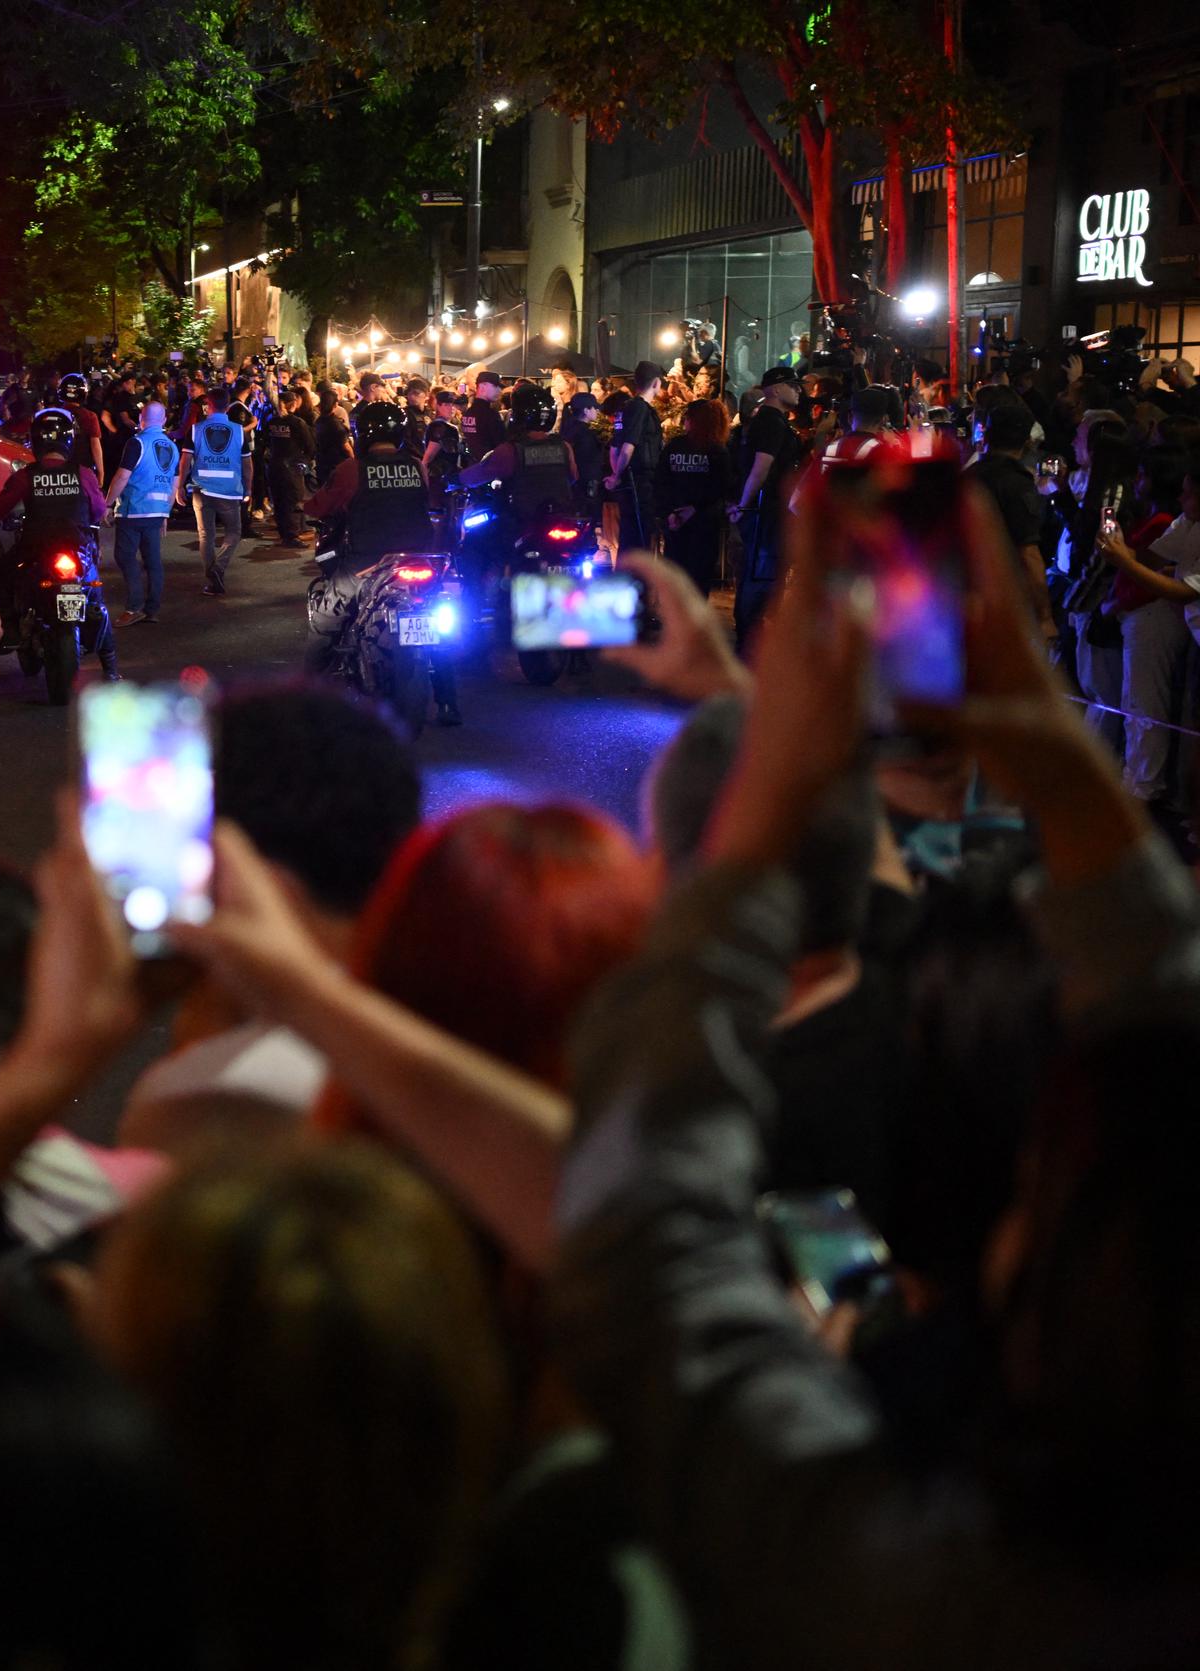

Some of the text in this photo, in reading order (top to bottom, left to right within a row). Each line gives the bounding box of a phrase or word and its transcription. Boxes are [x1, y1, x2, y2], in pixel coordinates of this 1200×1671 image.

[1079, 188, 1150, 242] CLUB
[1079, 235, 1154, 287] DE BAR
[203, 456, 231, 465] POLICIA
[669, 453, 710, 466] POLICIA
[366, 464, 421, 480] POLICIA
[33, 473, 80, 488] POLICIA
[368, 478, 423, 489] DE LA CIUDAD
[34, 487, 80, 497] DE LA CIUDAD
